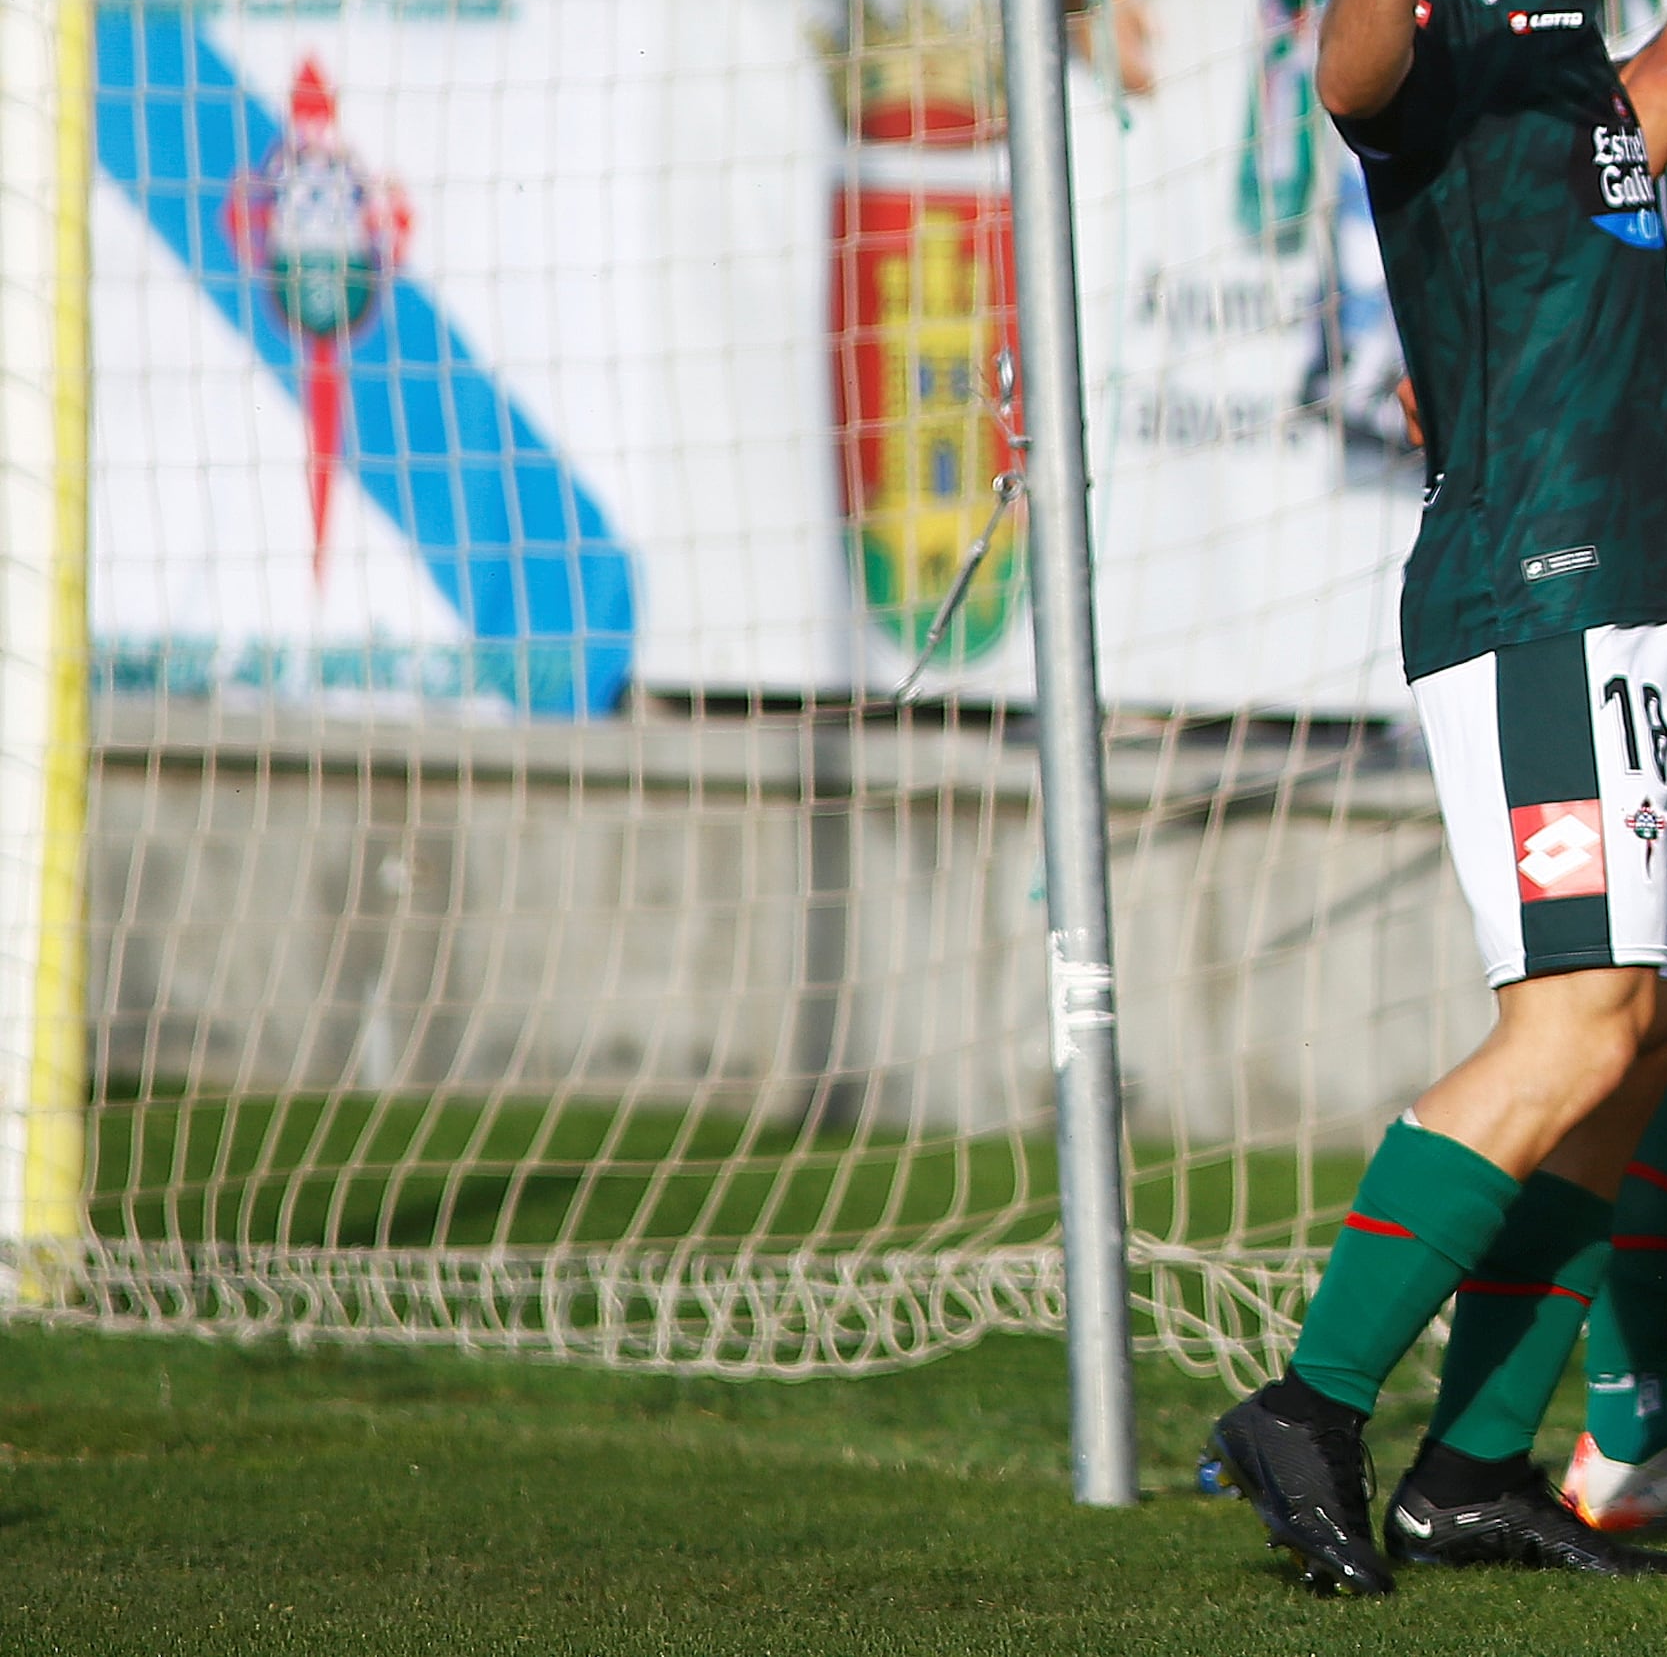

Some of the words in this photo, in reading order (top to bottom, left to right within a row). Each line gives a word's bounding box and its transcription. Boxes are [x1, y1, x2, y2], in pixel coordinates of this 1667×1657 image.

[1529, 11, 1583, 29] LOTTO
[1592, 126, 1648, 164] Estrel
[1601, 164, 1656, 208] Gali
